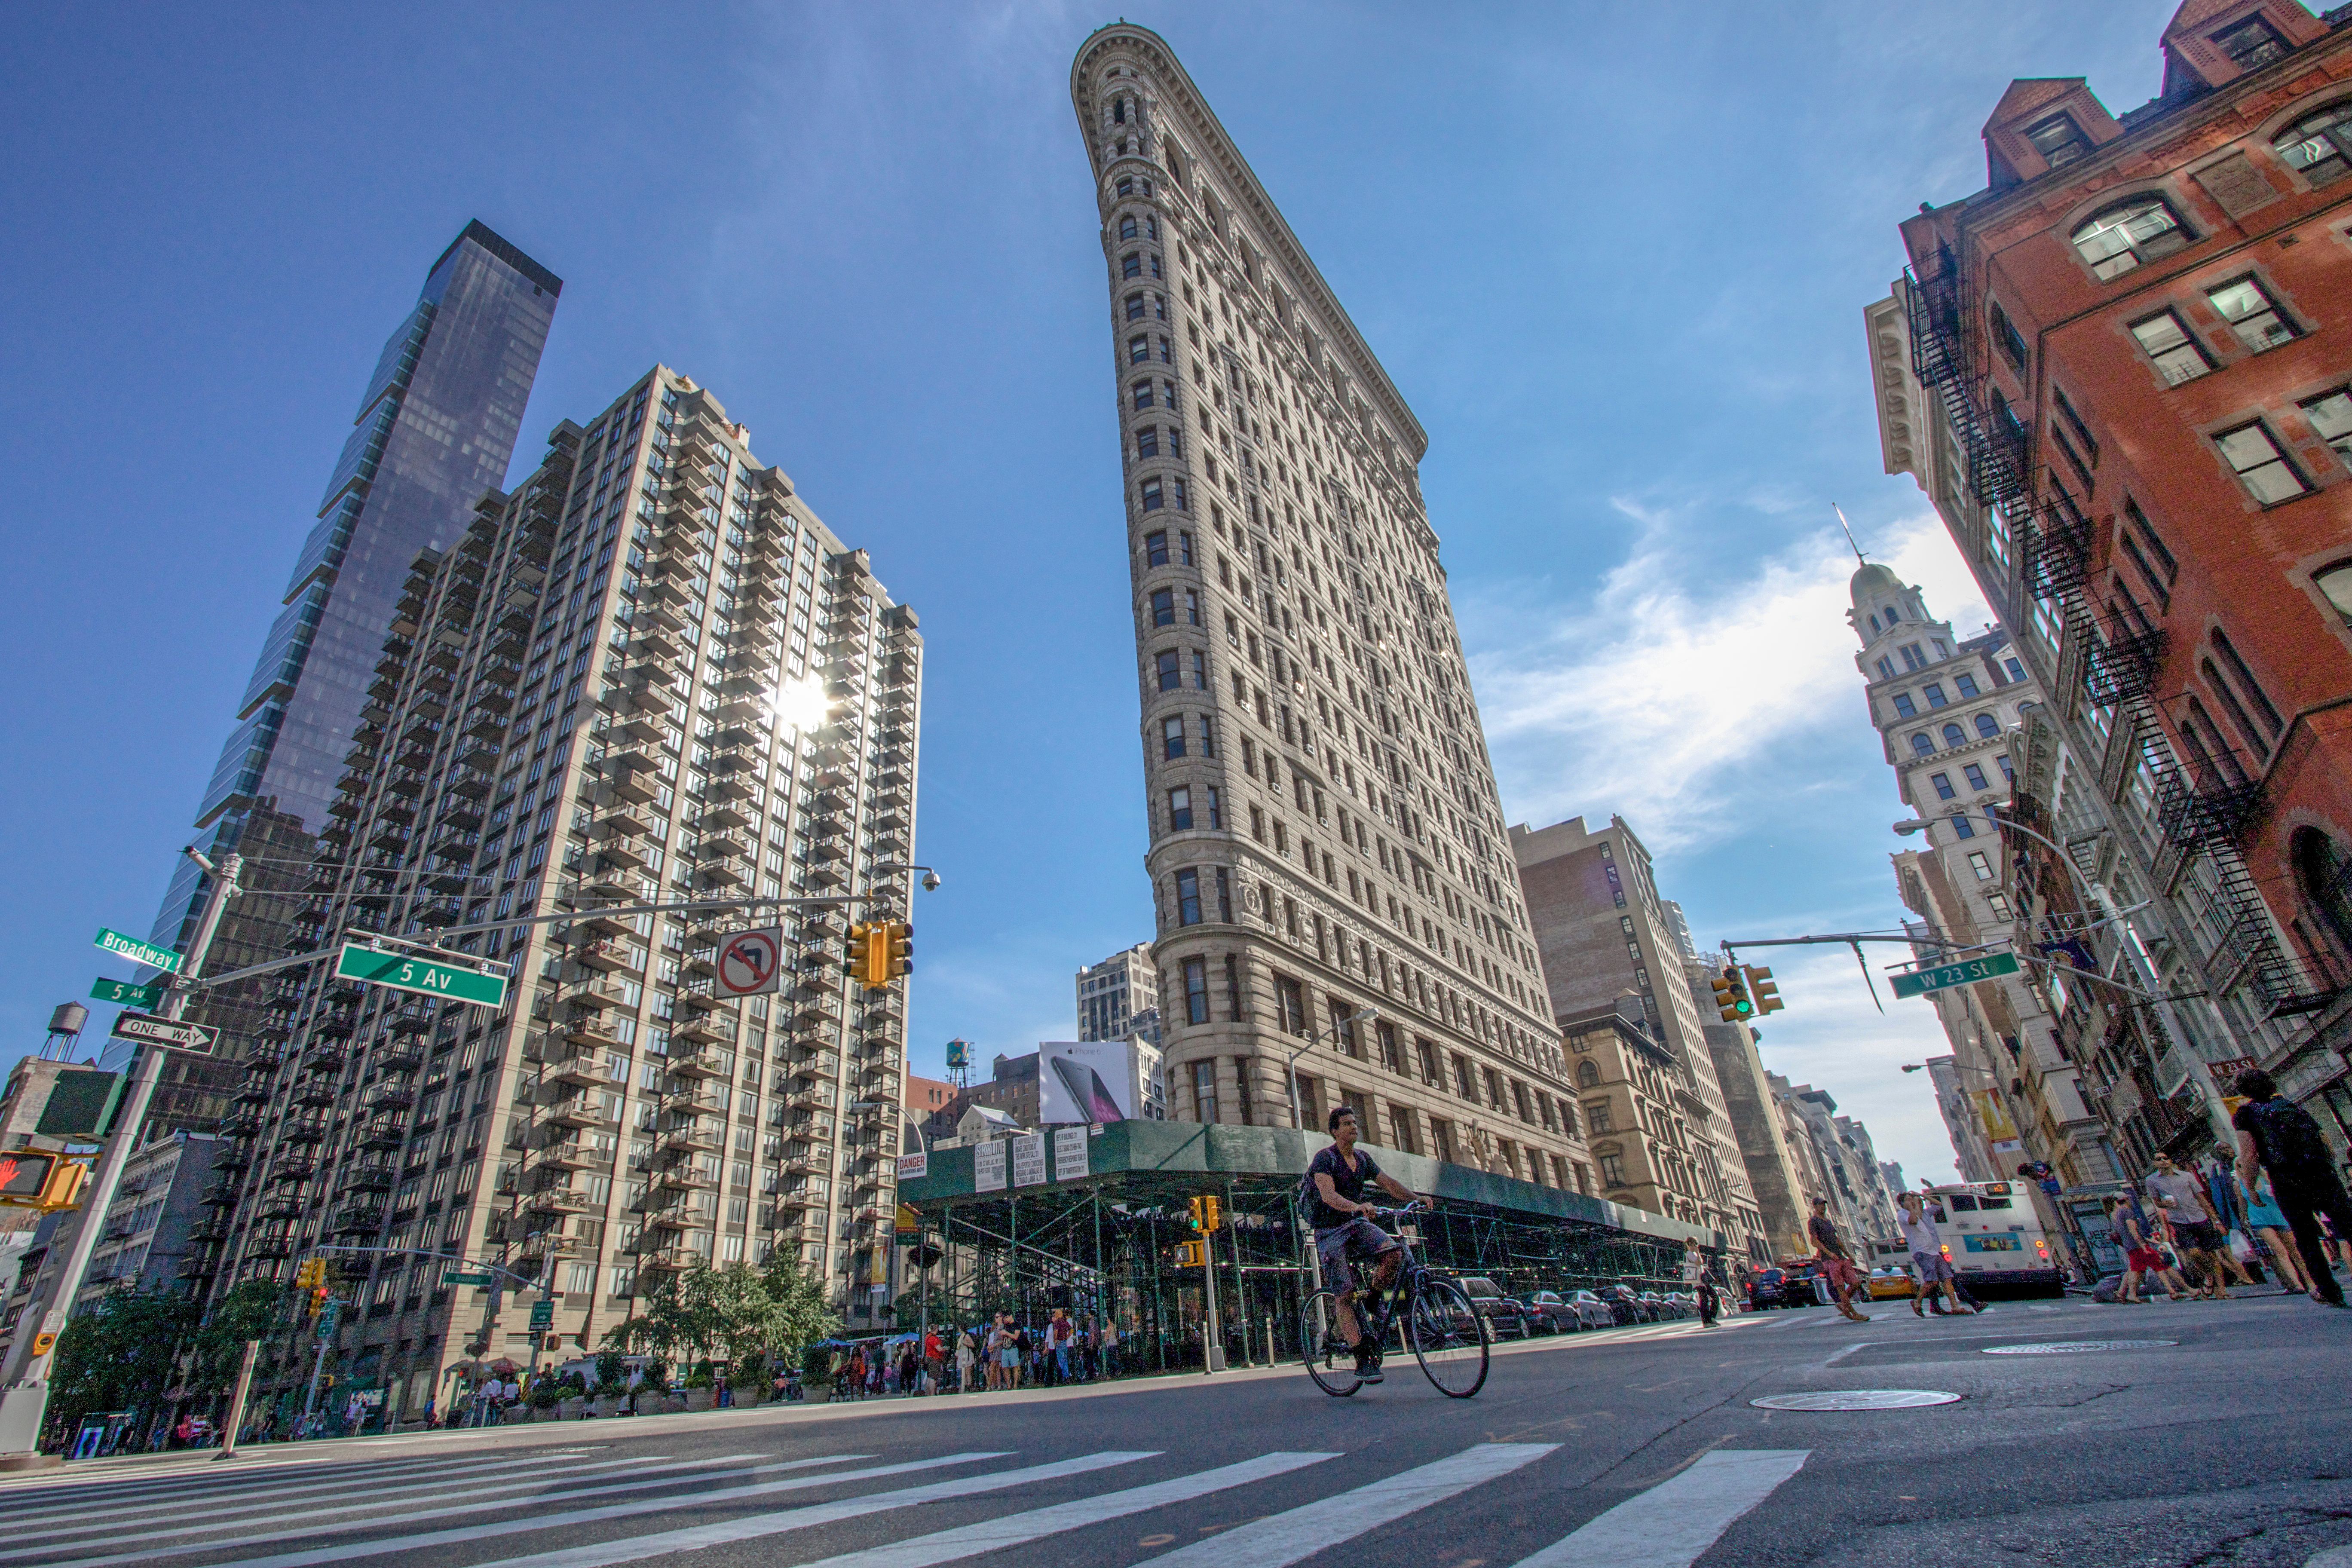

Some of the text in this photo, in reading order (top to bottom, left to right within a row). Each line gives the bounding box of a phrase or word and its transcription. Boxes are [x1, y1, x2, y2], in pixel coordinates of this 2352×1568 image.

[103, 932, 173, 968] Broadway
[400, 963, 414, 982] 5
[1919, 962, 1989, 988] W 23 St
[112, 984, 125, 999] 5
[131, 1022, 202, 1043] ONE WAY
[2212, 1060, 2252, 1075] W 23 St
[976, 1141, 1005, 1157] SKYLINE
[900, 1156, 925, 1170] DANGER
